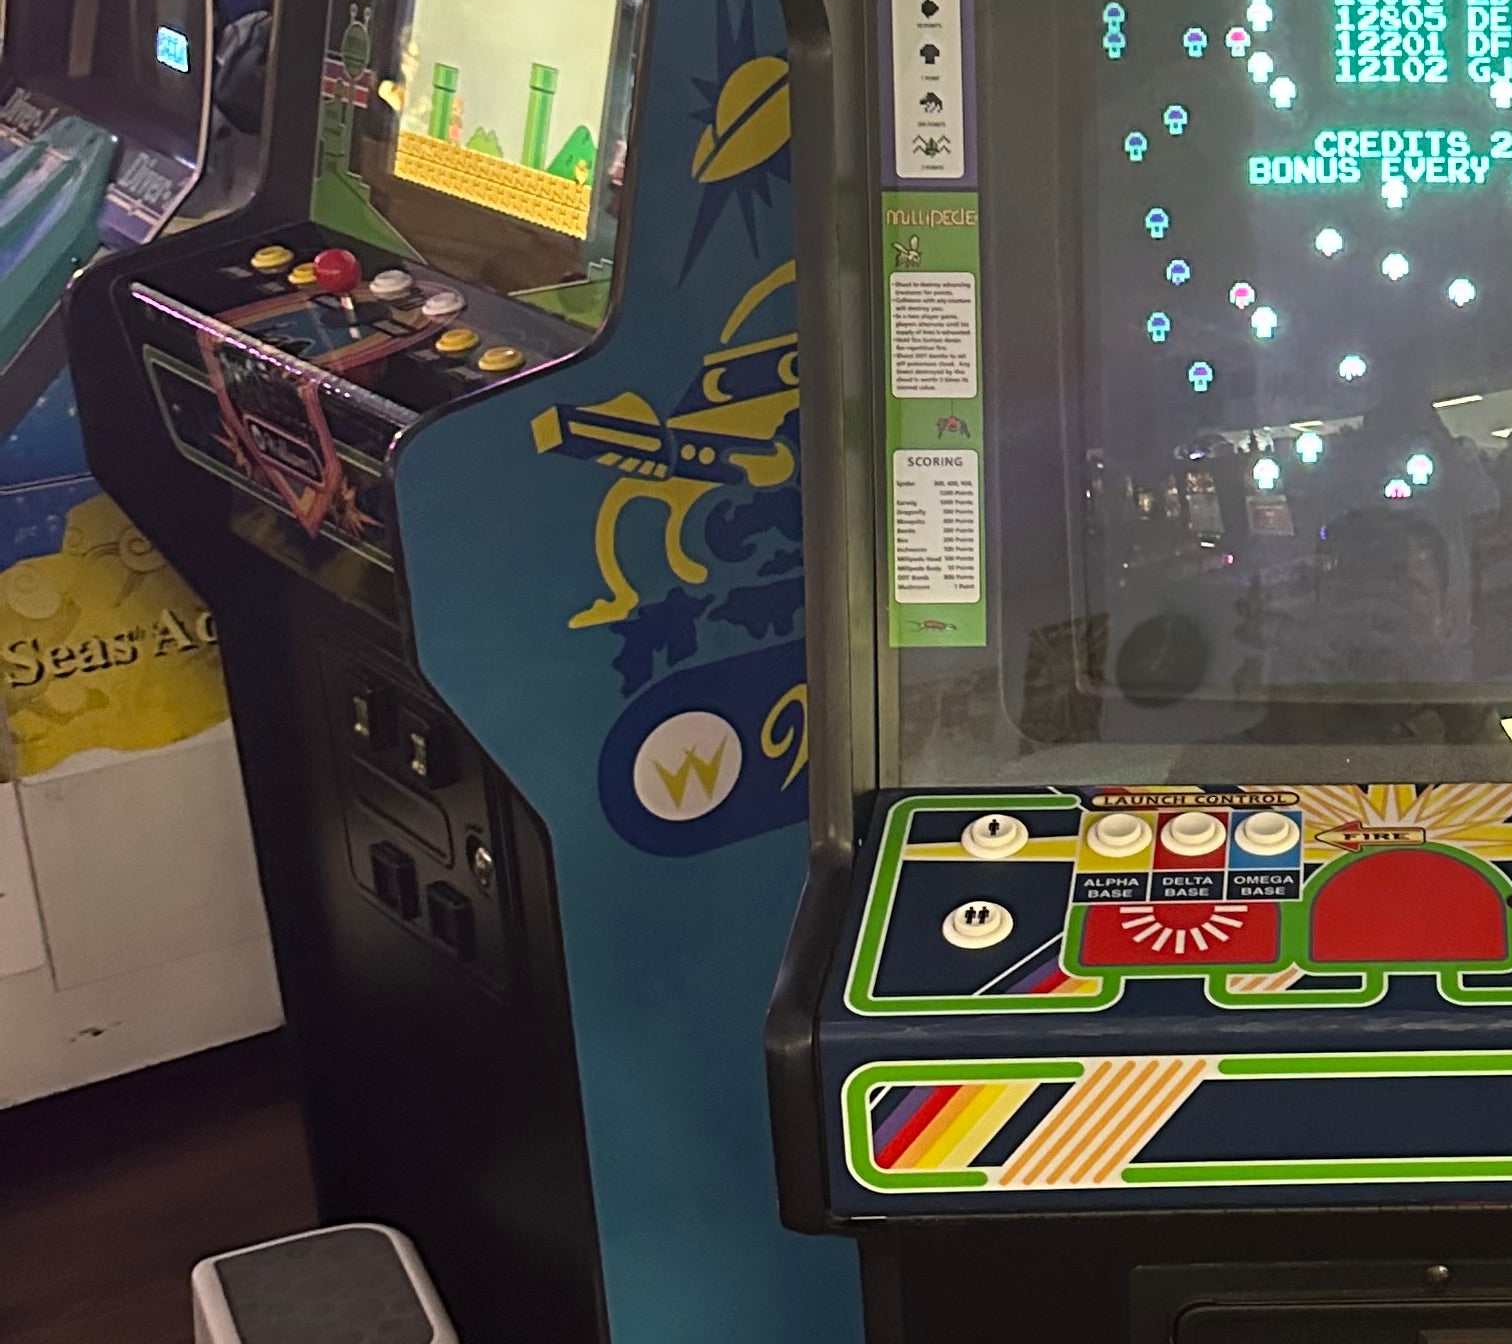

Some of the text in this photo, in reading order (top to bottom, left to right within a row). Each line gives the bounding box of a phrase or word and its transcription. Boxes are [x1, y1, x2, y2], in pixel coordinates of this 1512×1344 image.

[1335, 6, 1447, 32] 12805
[1335, 32, 1447, 57] 12201
[1335, 57, 1448, 83] 12102
[1314, 130, 1471, 159] CREDITS
[1249, 158, 1361, 185] BONUS
[1382, 156, 1490, 184] EVERY
[907, 456, 964, 467] SCORING
[1, 637, 138, 688] Seas
[1103, 793, 1288, 807] LAUNCH CONTROL
[1343, 831, 1412, 842] FIRE
[1083, 877, 1140, 889] ALPHA
[1161, 875, 1214, 887] DELTA
[1233, 874, 1295, 886] OMEGA
[1087, 888, 1133, 899] BASE
[1164, 887, 1210, 898] BASE
[1240, 885, 1287, 897] BASE
